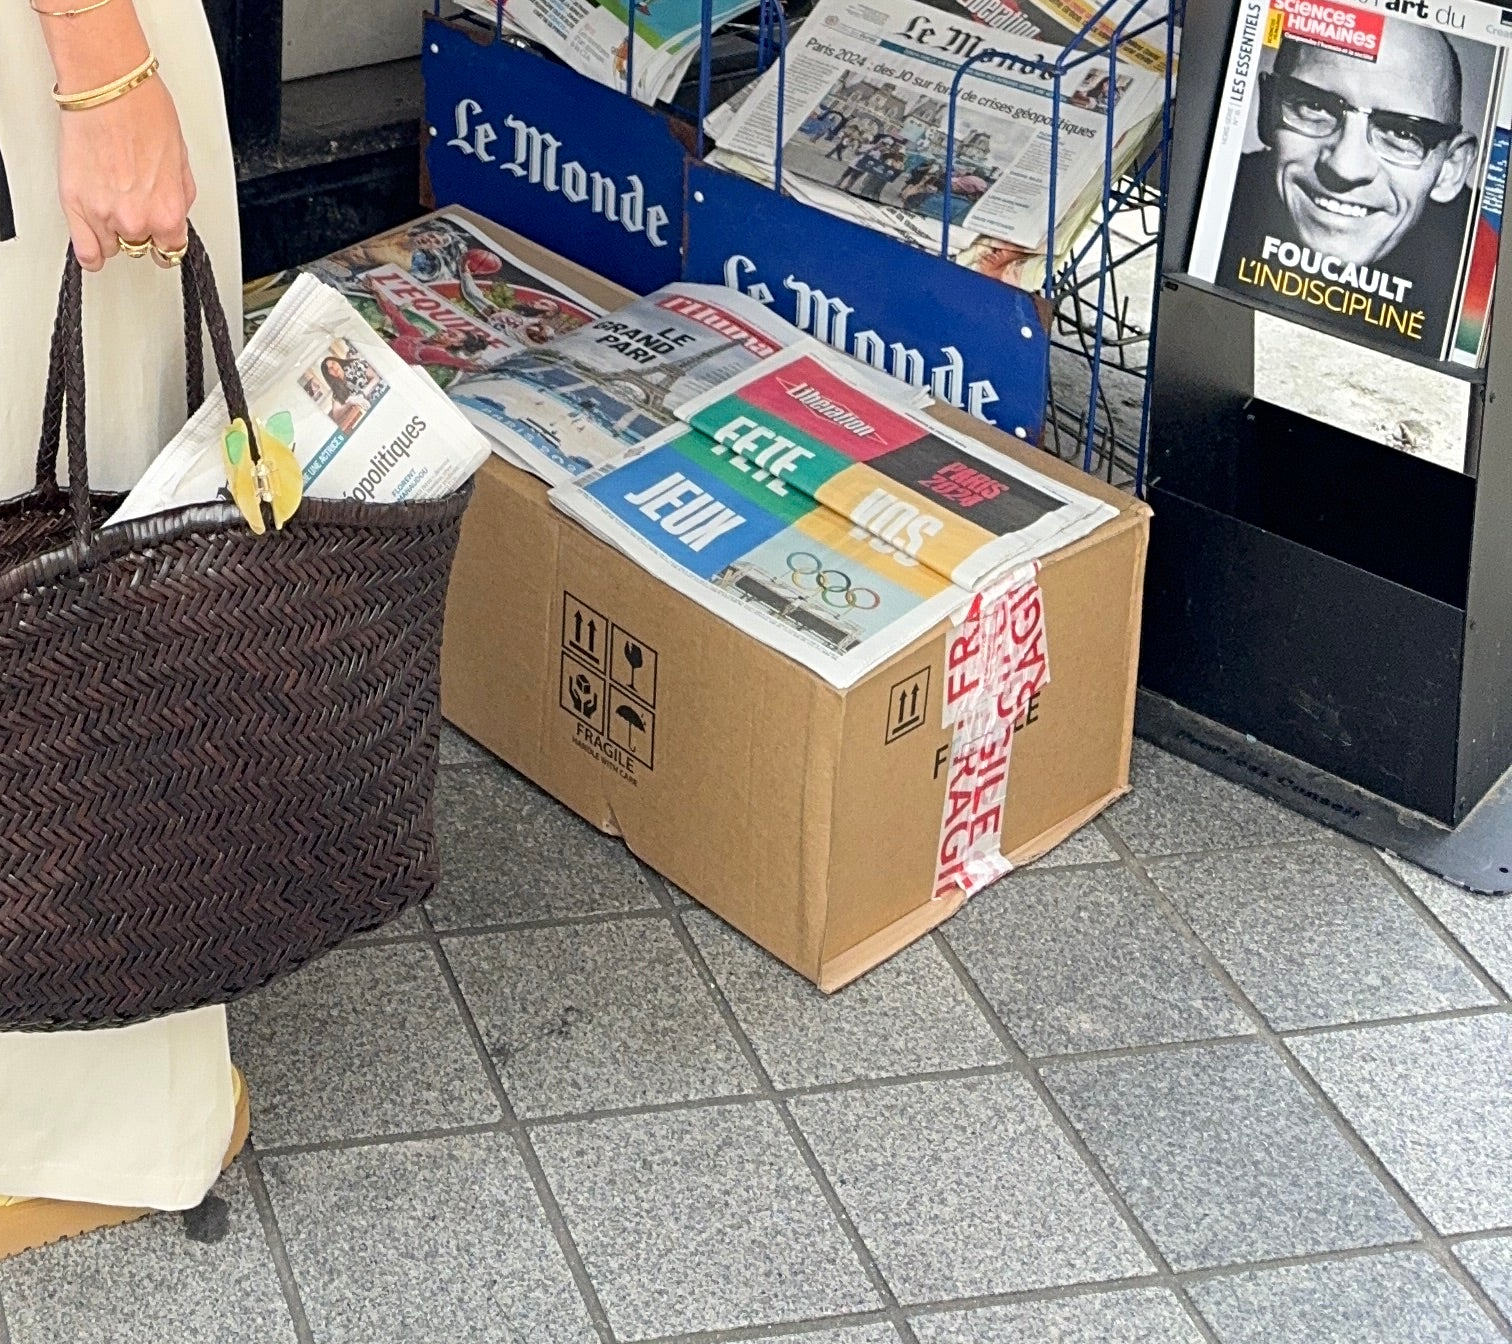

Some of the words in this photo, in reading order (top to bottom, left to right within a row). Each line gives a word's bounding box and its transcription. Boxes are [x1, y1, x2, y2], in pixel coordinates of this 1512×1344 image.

[893, 15, 937, 45] Le
[1436, 5, 1466, 30] du
[1234, 3, 1261, 78] ESSENTIELS
[805, 36, 831, 59] Paris
[833, 46, 868, 70] 2024
[873, 61, 896, 79] des
[913, 75, 933, 89] sur
[961, 89, 979, 103] de
[977, 97, 1014, 114] crises
[1231, 78, 1246, 103] LES
[446, 98, 499, 164] Le
[504, 113, 670, 249] Monde
[1261, 235, 1413, 304] FOUCAULT
[1238, 256, 1426, 341] L'INDISCIPLINÉ
[595, 319, 676, 356] GRAND
[603, 333, 659, 365] PARI
[664, 326, 696, 348] LE
[937, 461, 1010, 501] PARIS
[624, 471, 746, 553] JEUX
[576, 722, 634, 773] FRAGILE
